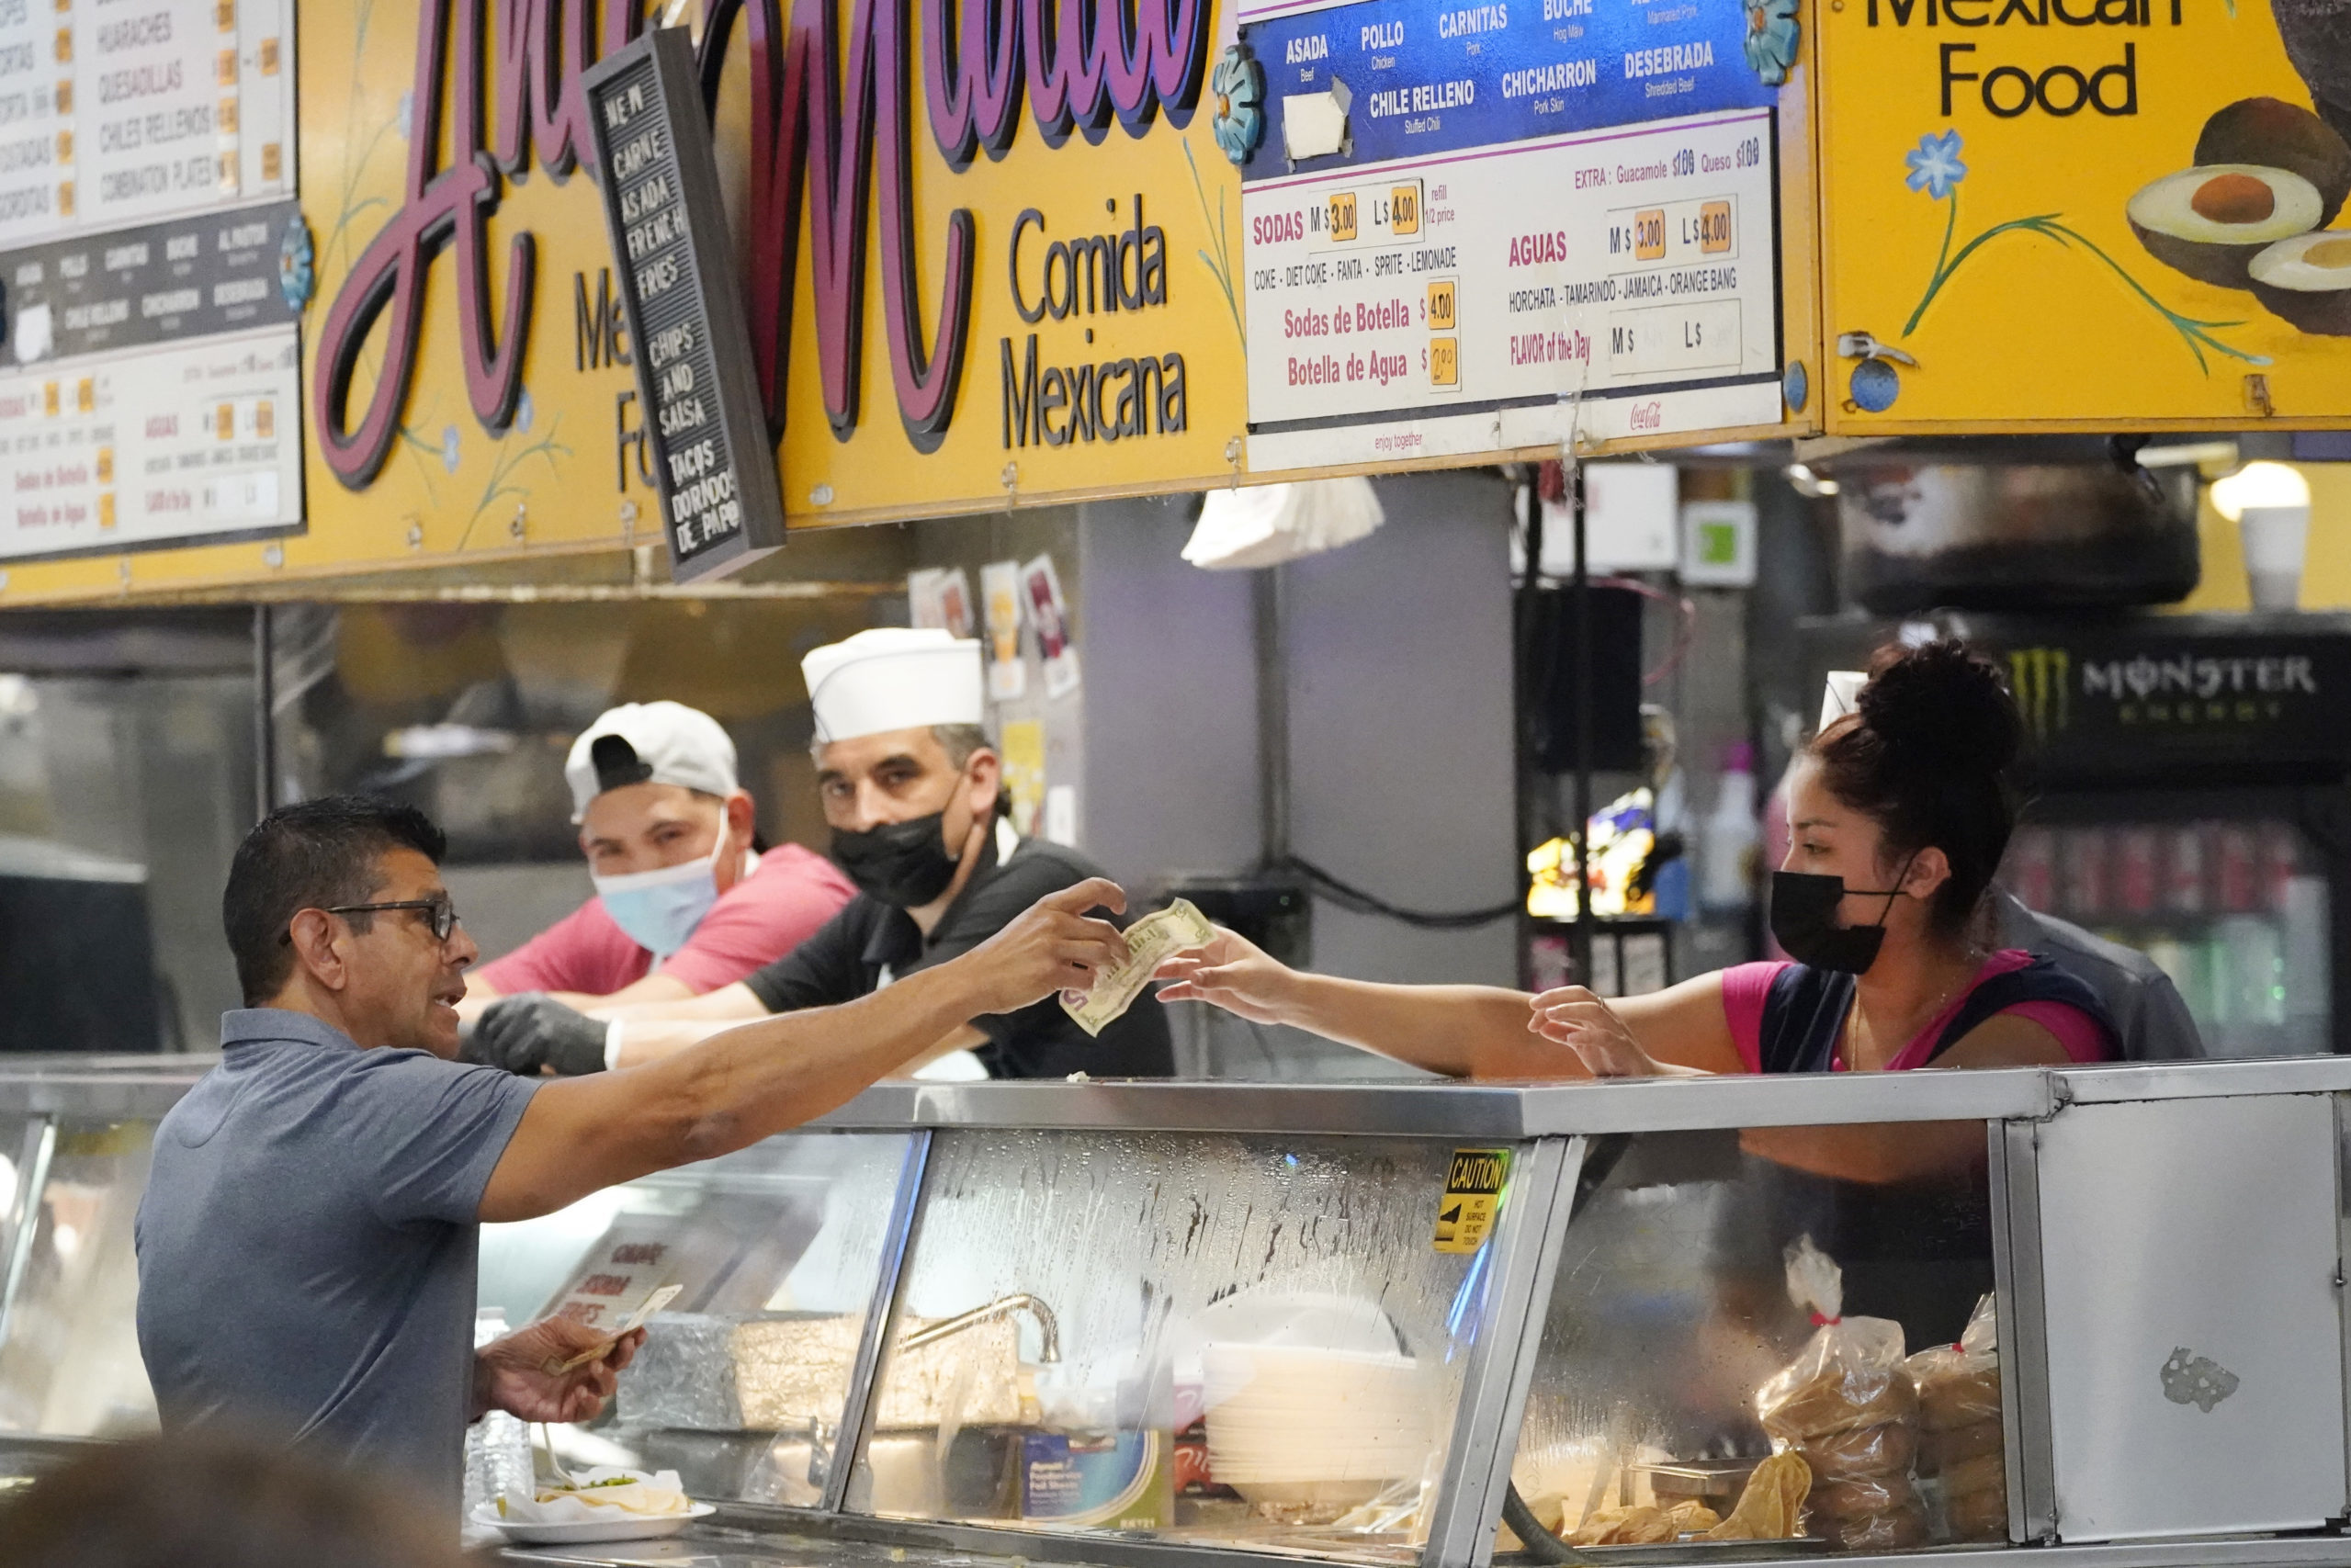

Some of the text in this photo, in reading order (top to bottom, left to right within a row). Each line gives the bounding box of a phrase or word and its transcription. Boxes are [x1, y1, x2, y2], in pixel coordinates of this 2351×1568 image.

[1439, 3, 1508, 39] CARNITAS
[1543, 0, 1594, 21] BUCHE
[1286, 34, 1328, 64] ASADA
[1361, 20, 1404, 51] POLLO
[1554, 24, 1584, 44] Hog Maw
[1300, 68, 1315, 83] Beef
[1371, 55, 1396, 71] Chicken
[1624, 40, 1714, 79] DESEBRADA
[99, 58, 183, 105] QUESADILLAS
[1502, 59, 1596, 99] CHICHARRON
[1645, 75, 1695, 99] Shredded Beef
[1939, 42, 2139, 118] Food
[1370, 79, 1475, 118] CHILE RELLENO
[1534, 97, 1565, 115] Pork Skin
[1405, 117, 1441, 135] Stuffed Chili
[614, 130, 664, 180] CARNE
[1617, 160, 1667, 184] Guacamole
[1701, 153, 1731, 173] Queso
[622, 175, 671, 223] ASADA
[1431, 185, 1448, 202] refill
[627, 207, 684, 260] FRENCH
[1253, 210, 1304, 245] SODAS
[1310, 207, 1320, 231] M
[1374, 200, 1381, 226] L
[1425, 208, 1455, 227] 1/2 price
[1509, 231, 1567, 267] AGUAS
[1610, 227, 1621, 254] M
[1683, 218, 1690, 244] L
[1009, 192, 1168, 324] Comida
[1255, 246, 1456, 291] COKE DIET COKE FANTA SPRITE LEMONADE
[637, 254, 679, 300] FRIES
[1509, 267, 1736, 312] HORCHATA TAMARINDO JAMAICA ORANGE BANG
[1284, 299, 1409, 338] Sodas de Botella
[649, 322, 694, 367] CHIPS
[1510, 329, 1590, 367] FLAVOR of the Day
[1612, 327, 1623, 354] M
[1685, 321, 1692, 348] L
[662, 364, 694, 402] AND
[1288, 350, 1407, 387] Botella de Agua
[1000, 328, 1188, 450] Mexicana
[659, 398, 706, 436] SALSA
[1375, 431, 1423, 451] enjoy together
[668, 439, 715, 487] TACOS
[676, 518, 698, 554] DE
[2083, 653, 2315, 700] MONSTER
[1452, 1157, 1503, 1189] CAUTION
[1465, 1213, 1486, 1222] SURFACE
